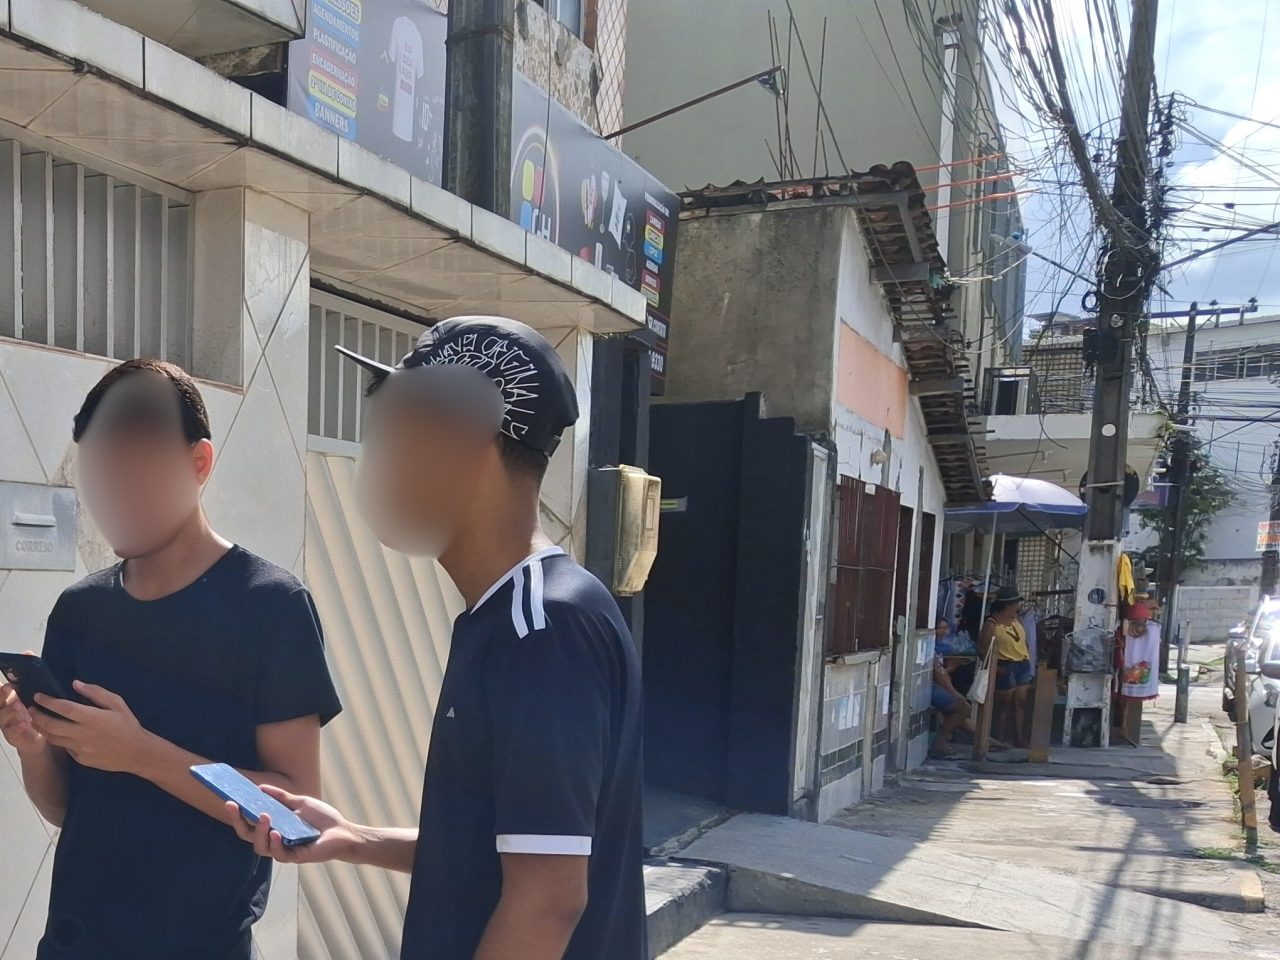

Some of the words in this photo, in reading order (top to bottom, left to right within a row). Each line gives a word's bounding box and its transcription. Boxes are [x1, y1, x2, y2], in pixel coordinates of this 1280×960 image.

[312, 3, 359, 41] AGENDAMENTOS
[313, 28, 357, 64] PLASTIFICAÇÃO
[312, 53, 355, 87] ENCADERNAÇÃO
[315, 102, 349, 133] BANNERS
[15, 539, 53, 553] CORREIO
